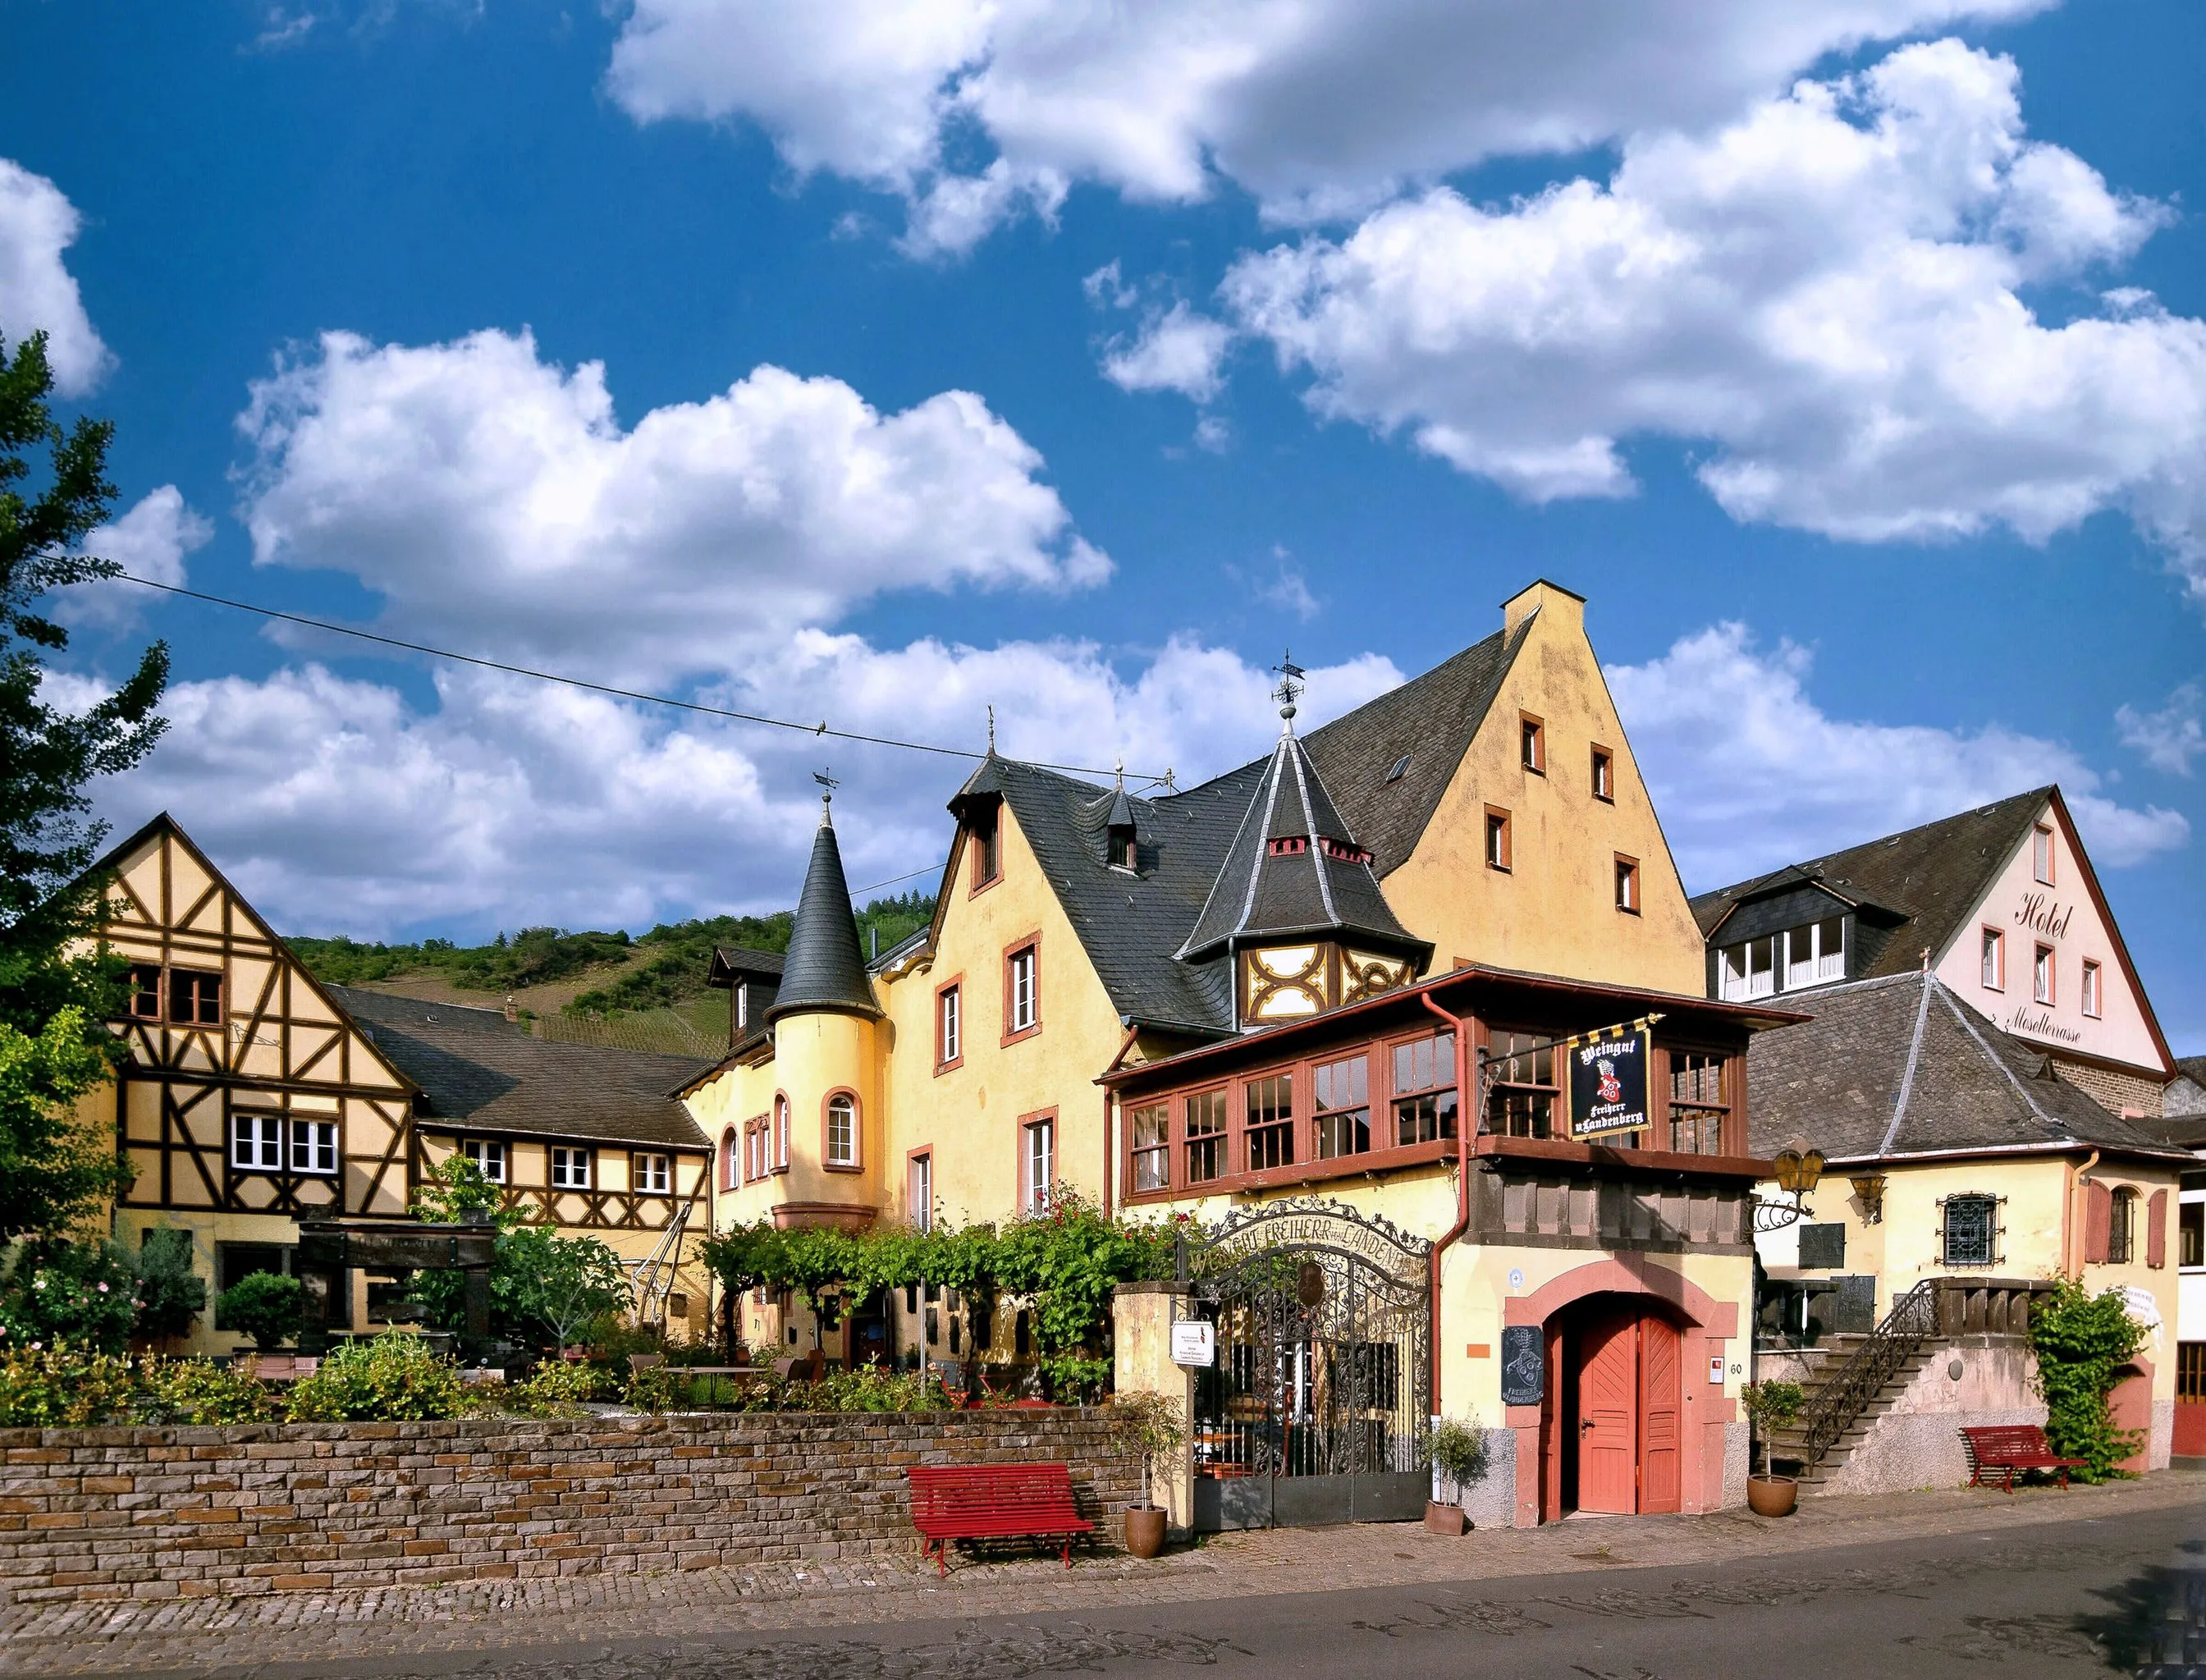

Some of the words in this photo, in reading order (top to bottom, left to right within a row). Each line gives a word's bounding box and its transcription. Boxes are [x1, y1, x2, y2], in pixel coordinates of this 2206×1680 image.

[2015, 892, 2073, 940] Hotel
[2007, 1005, 2081, 1043] Moselterrasse
[1580, 1040, 1636, 1065] Weingut
[1590, 1103, 1626, 1118] Freiherr
[1265, 1219, 1331, 1247] FREIHERR
[1731, 1364, 1741, 1375] 60
